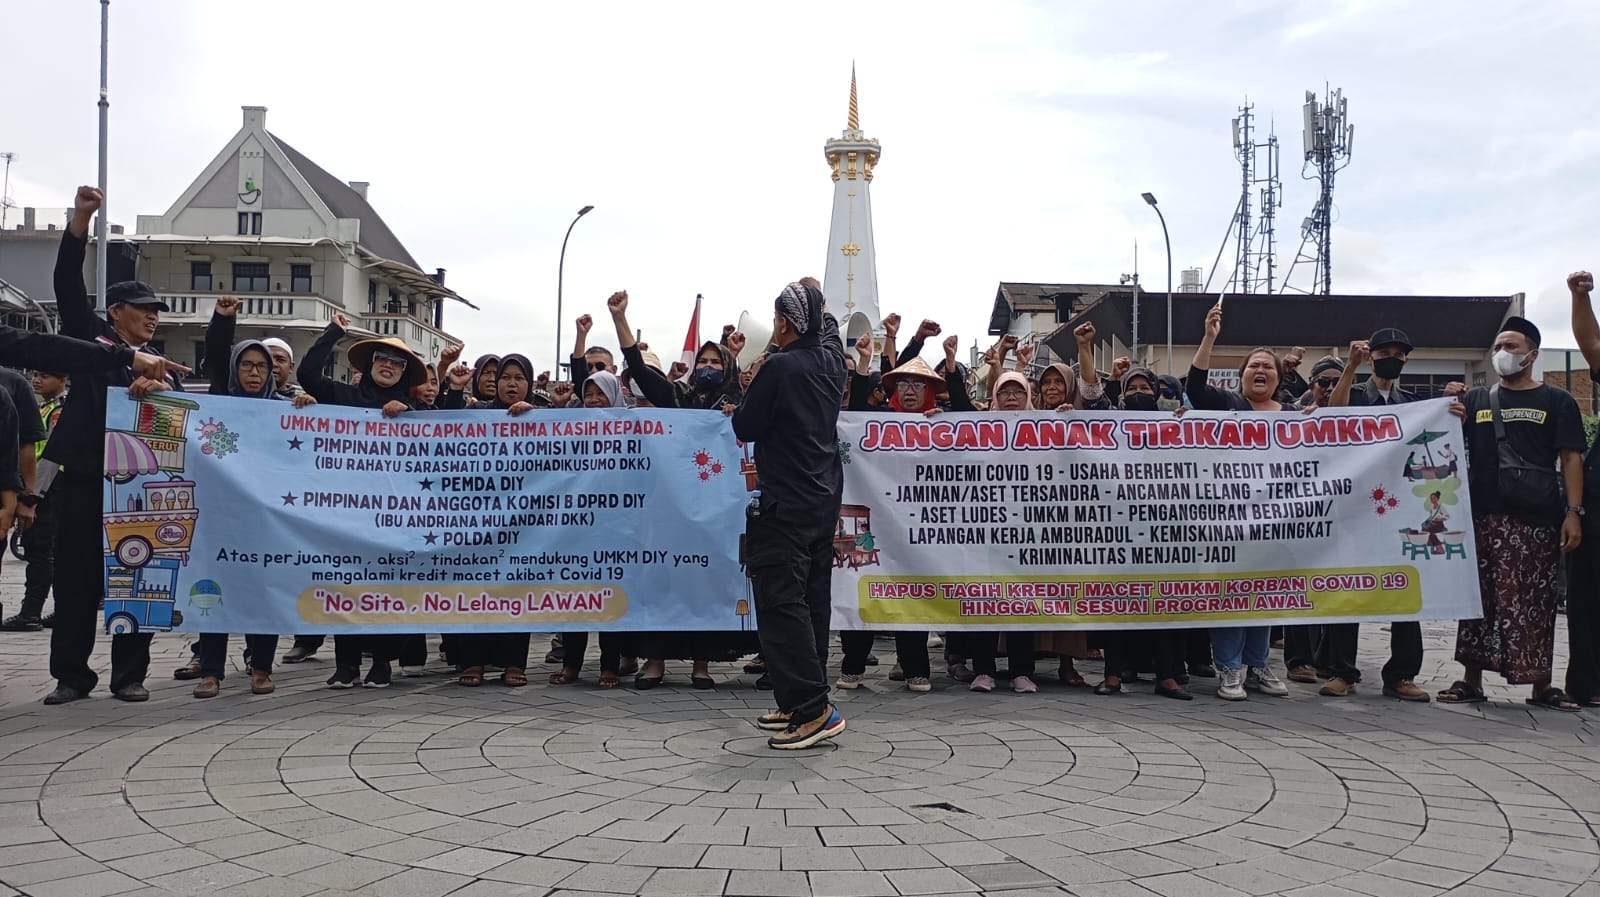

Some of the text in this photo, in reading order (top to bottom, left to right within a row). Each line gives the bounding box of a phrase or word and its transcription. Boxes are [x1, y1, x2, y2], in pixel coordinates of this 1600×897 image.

[280, 414, 330, 433] UMKM
[334, 419, 360, 434] DIY
[365, 421, 486, 438] MENGUCAPKAN
[492, 421, 548, 437] TERIMA
[552, 420, 599, 436] KASIH
[603, 420, 664, 435] KEPADA
[859, 414, 1403, 450] JANGAN ANAK TIRIKAN UMKM
[147, 440, 178, 452] SERUT
[313, 437, 642, 457] PIMPINAN DAN ANGGOTA KOMISI VII DPR RI
[315, 455, 651, 473] (IBU RAHAYU SARASWATI D DJOJOHADIKUSUMO DKK)
[916, 464, 981, 482] PANDEMI
[986, 465, 1029, 482] COVID
[1036, 464, 1053, 481] 19
[1070, 463, 1119, 480] USAHA
[1125, 462, 1198, 479] BERHENTI
[1213, 462, 1264, 480] KREDIT
[1270, 460, 1320, 478] MACET
[441, 476, 524, 492] PEMDA DIY
[896, 485, 1005, 504] JAMINAN/ASET
[1012, 485, 1100, 502] TERSANDRA
[1117, 482, 1191, 501] ANCAMAN
[1196, 481, 1250, 499] LELANG
[1267, 477, 1352, 499] TERLELANG
[303, 492, 646, 512] PIMPINAN DAN ANGGOTA KOMISI B DPRD DIY
[921, 506, 957, 524] ASET
[962, 507, 1007, 524] LUDES
[1024, 505, 1070, 523] UMKM
[1074, 505, 1111, 522] MATI
[1129, 503, 1248, 522] PENGANGGURAN
[1252, 499, 1333, 521] BERJIBUN/
[375, 508, 595, 528] (IBU ANDRIANA WULANDARI DKK)
[443, 531, 520, 546] POLDA DIY
[909, 527, 985, 545] LAPANGAN
[991, 527, 1035, 545] KERJA
[1040, 526, 1133, 544] AMBURADUL
[1150, 523, 1245, 543] KEMISKINAN
[1249, 520, 1333, 541] MENINGKAT
[216, 547, 259, 564] Atas
[263, 551, 362, 567] perjuangan
[509, 552, 589, 568] mendukung
[593, 551, 638, 564] UMKM
[642, 550, 668, 563] DIY
[673, 553, 709, 568] yang
[1019, 548, 1126, 565] KRIMINALITAS
[1132, 546, 1236, 564] MENJADI-JADI
[312, 567, 624, 585] mengalami kredit macet akibat Covid 19
[869, 572, 1408, 599] HAPUS TAGIH KREDIT MACET UMKM KORBAN COVID 19
[315, 591, 354, 614] "No
[360, 593, 405, 612] Sita
[424, 594, 450, 612] No
[457, 591, 522, 615] Lelang
[528, 589, 611, 611] LAWAN"
[960, 594, 1313, 616] HINGGA 5M SESUAI PROGRAM AWAL
